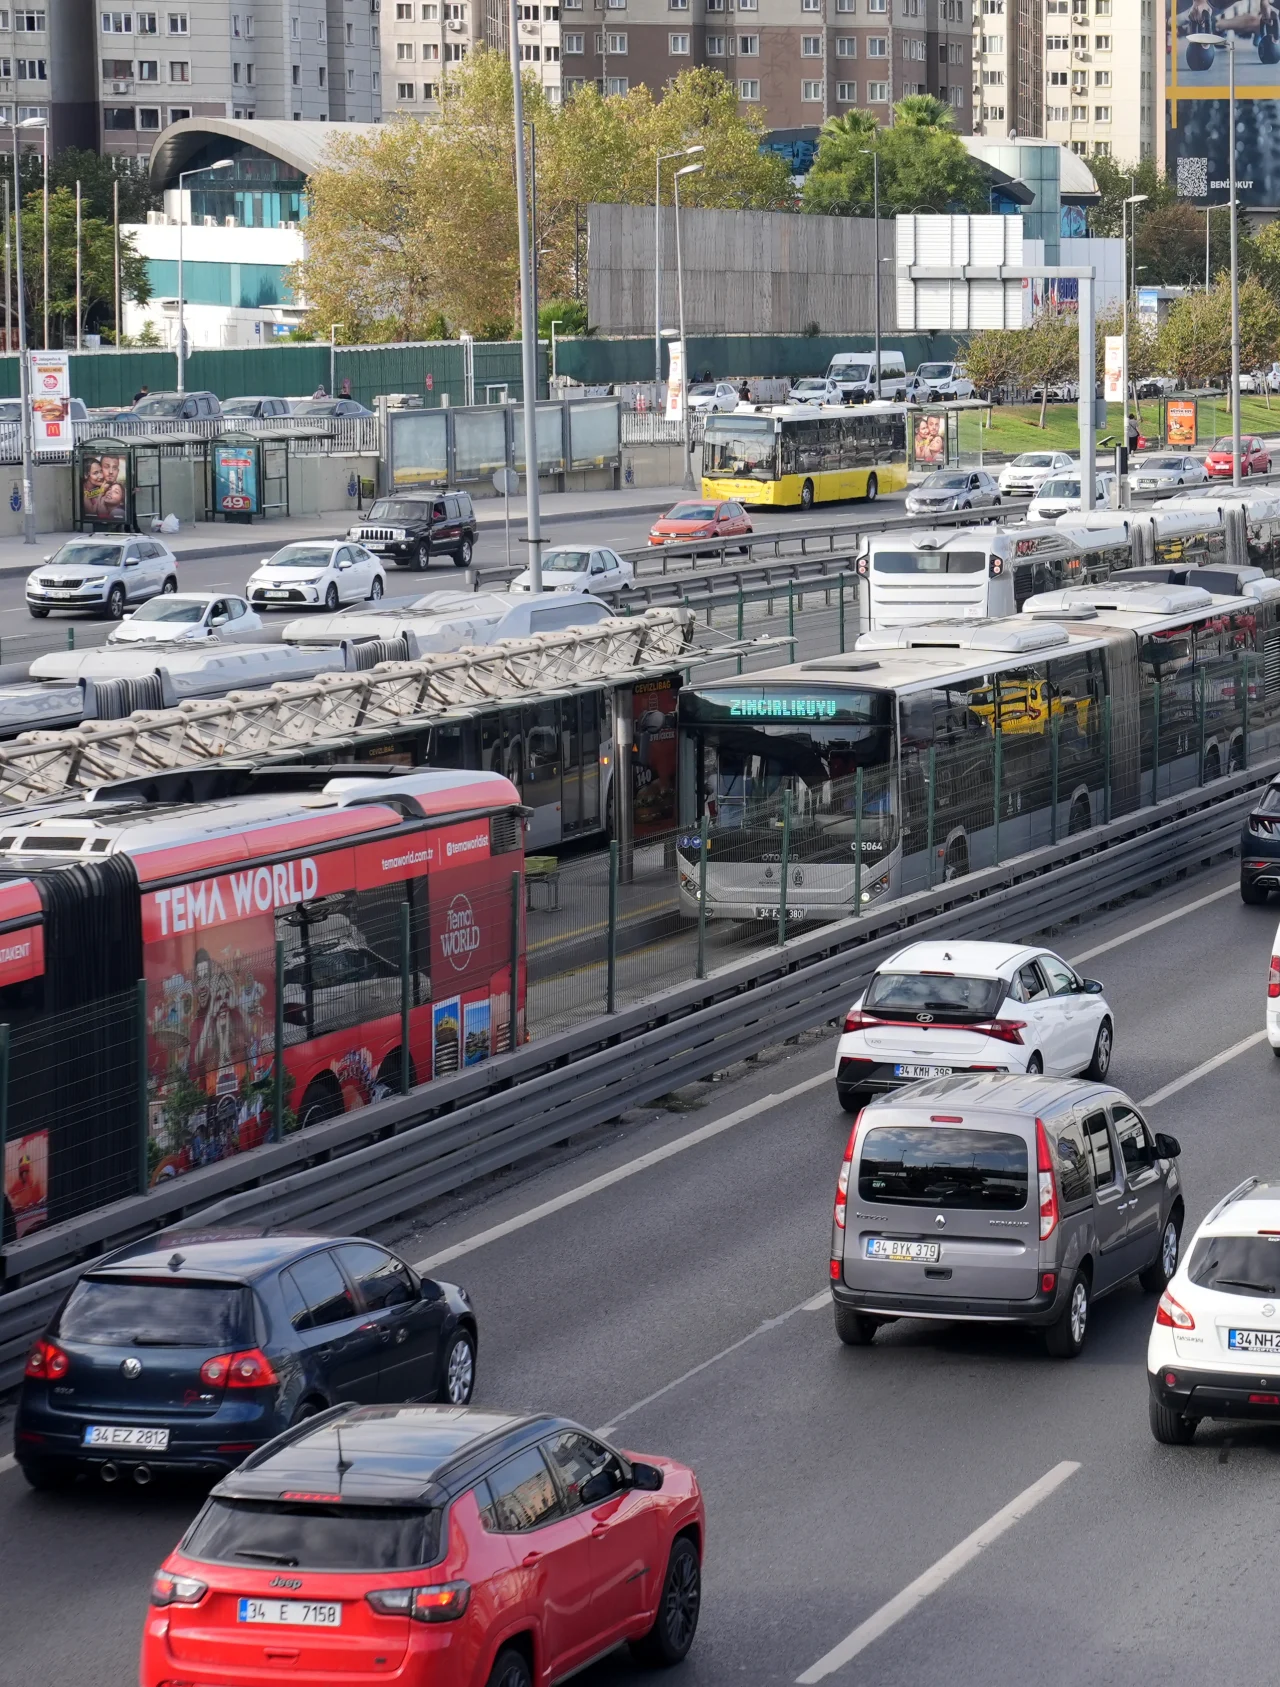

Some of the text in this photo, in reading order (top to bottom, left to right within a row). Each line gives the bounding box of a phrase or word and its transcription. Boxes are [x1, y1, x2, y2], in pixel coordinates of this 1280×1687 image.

[381, 849, 434, 872] temaworld.com.tr
[155, 858, 318, 936] TEMA WORLD
[440, 926, 480, 955] WORLD
[899, 1065, 910, 1075] 34
[913, 1066, 930, 1077] KMH
[875, 1241, 936, 1258] 34 BYK 379
[1237, 1331, 1252, 1346] 34
[1254, 1333, 1273, 1347] NH
[92, 1427, 168, 1446] 34 EZ 2812
[269, 1575, 303, 1591] Jeep
[248, 1602, 336, 1624] 34 E 7158
